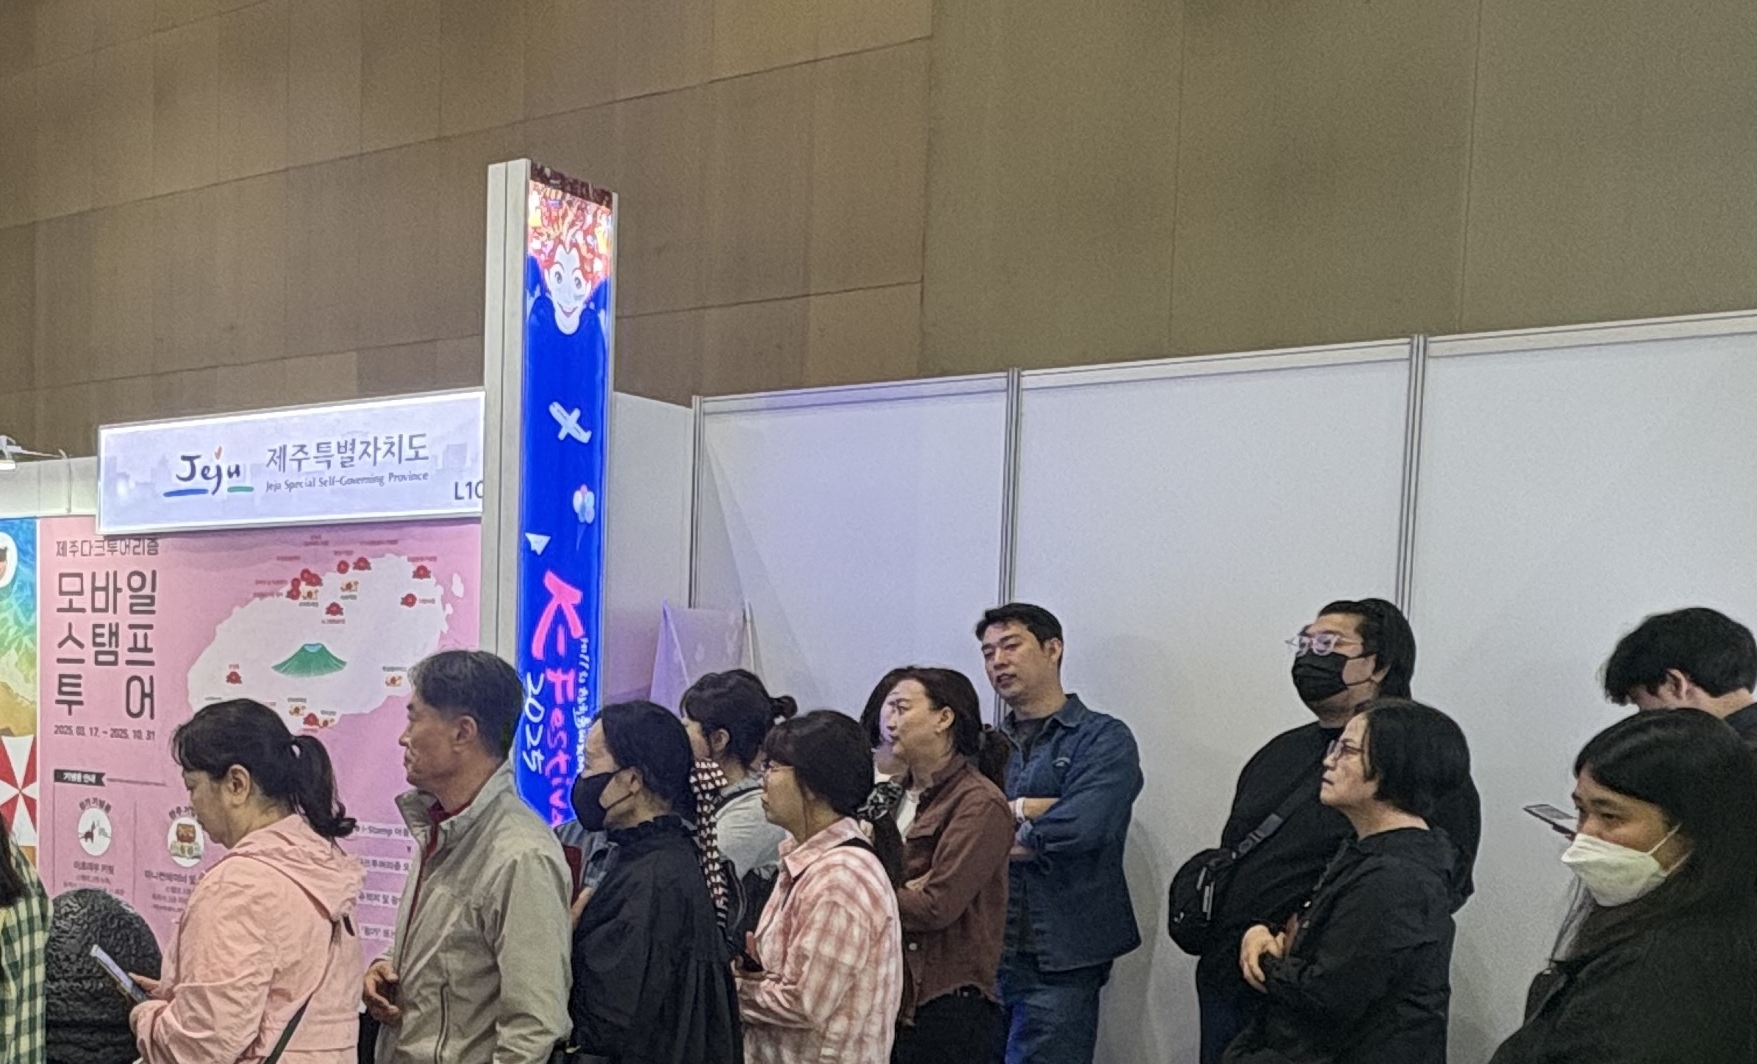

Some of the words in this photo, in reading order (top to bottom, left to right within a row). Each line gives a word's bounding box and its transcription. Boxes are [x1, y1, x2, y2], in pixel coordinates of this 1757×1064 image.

[176, 449, 241, 495] Jeju
[266, 433, 429, 473] 제주특별자치도
[266, 480, 281, 493] Jeju
[284, 477, 316, 492] Special
[388, 470, 429, 484] Province
[55, 538, 160, 558] 제주다크투어리즘
[56, 570, 157, 615] 모바일
[56, 621, 156, 667] 스탬프
[531, 570, 584, 828] K-Festiva
[522, 672, 545, 775] 2025
